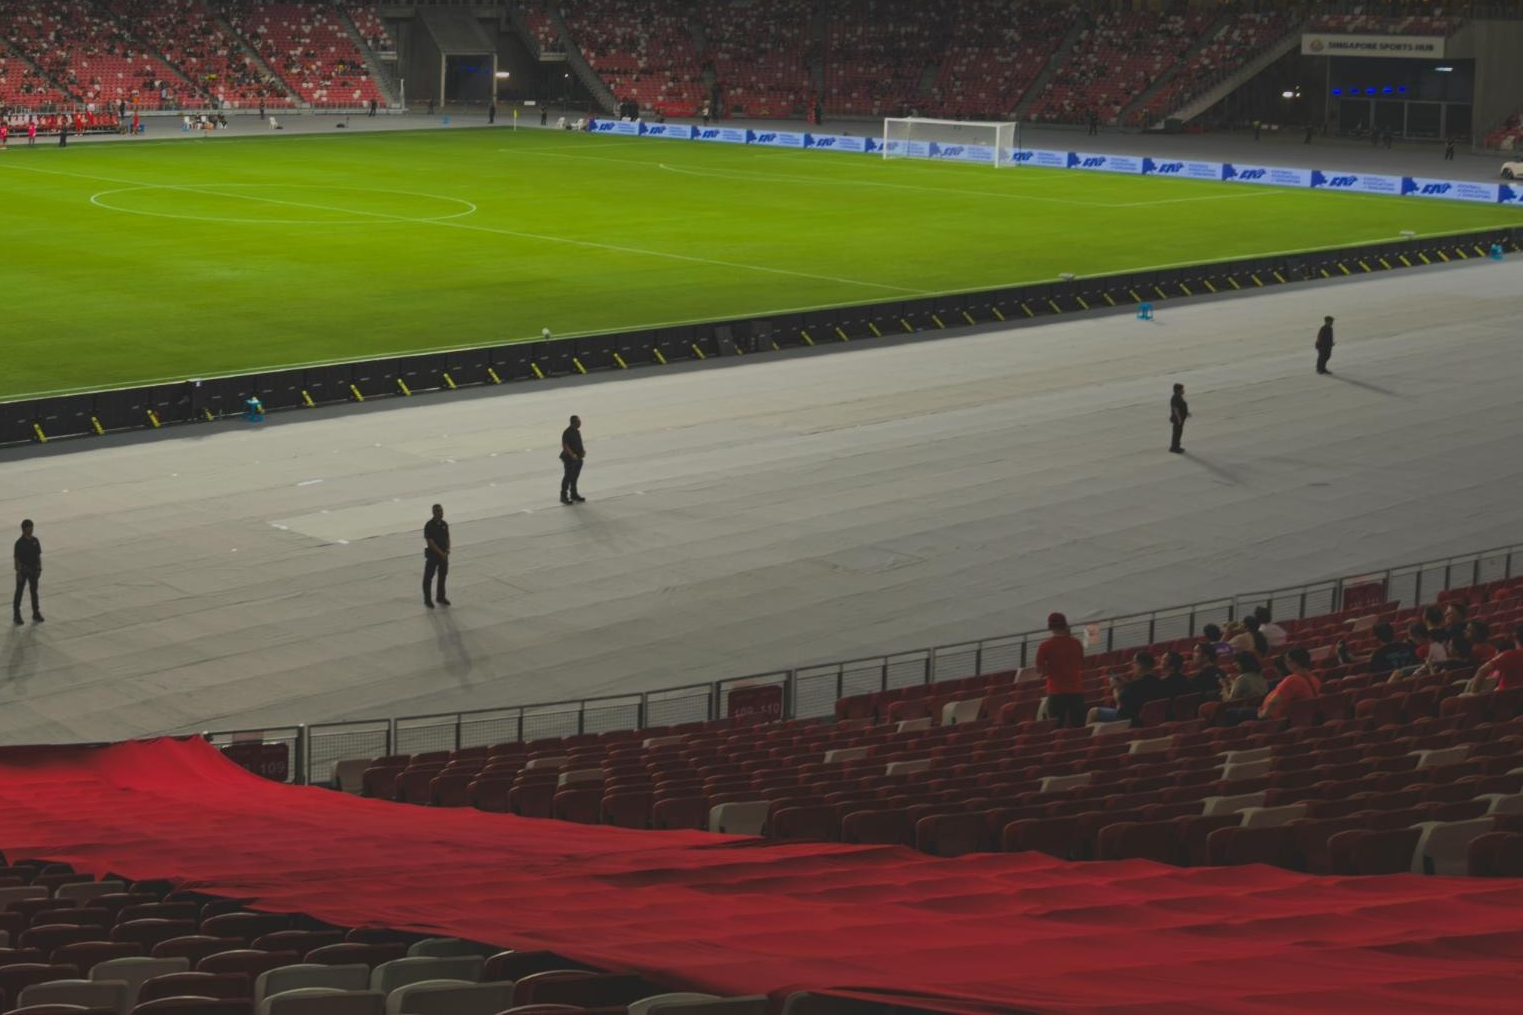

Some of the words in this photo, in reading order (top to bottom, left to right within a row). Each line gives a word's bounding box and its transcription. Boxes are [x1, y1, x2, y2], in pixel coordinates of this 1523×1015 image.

[1327, 40, 1377, 51] SINGAPORE
[1379, 41, 1413, 52] SPORTS
[1414, 43, 1434, 52] HUB
